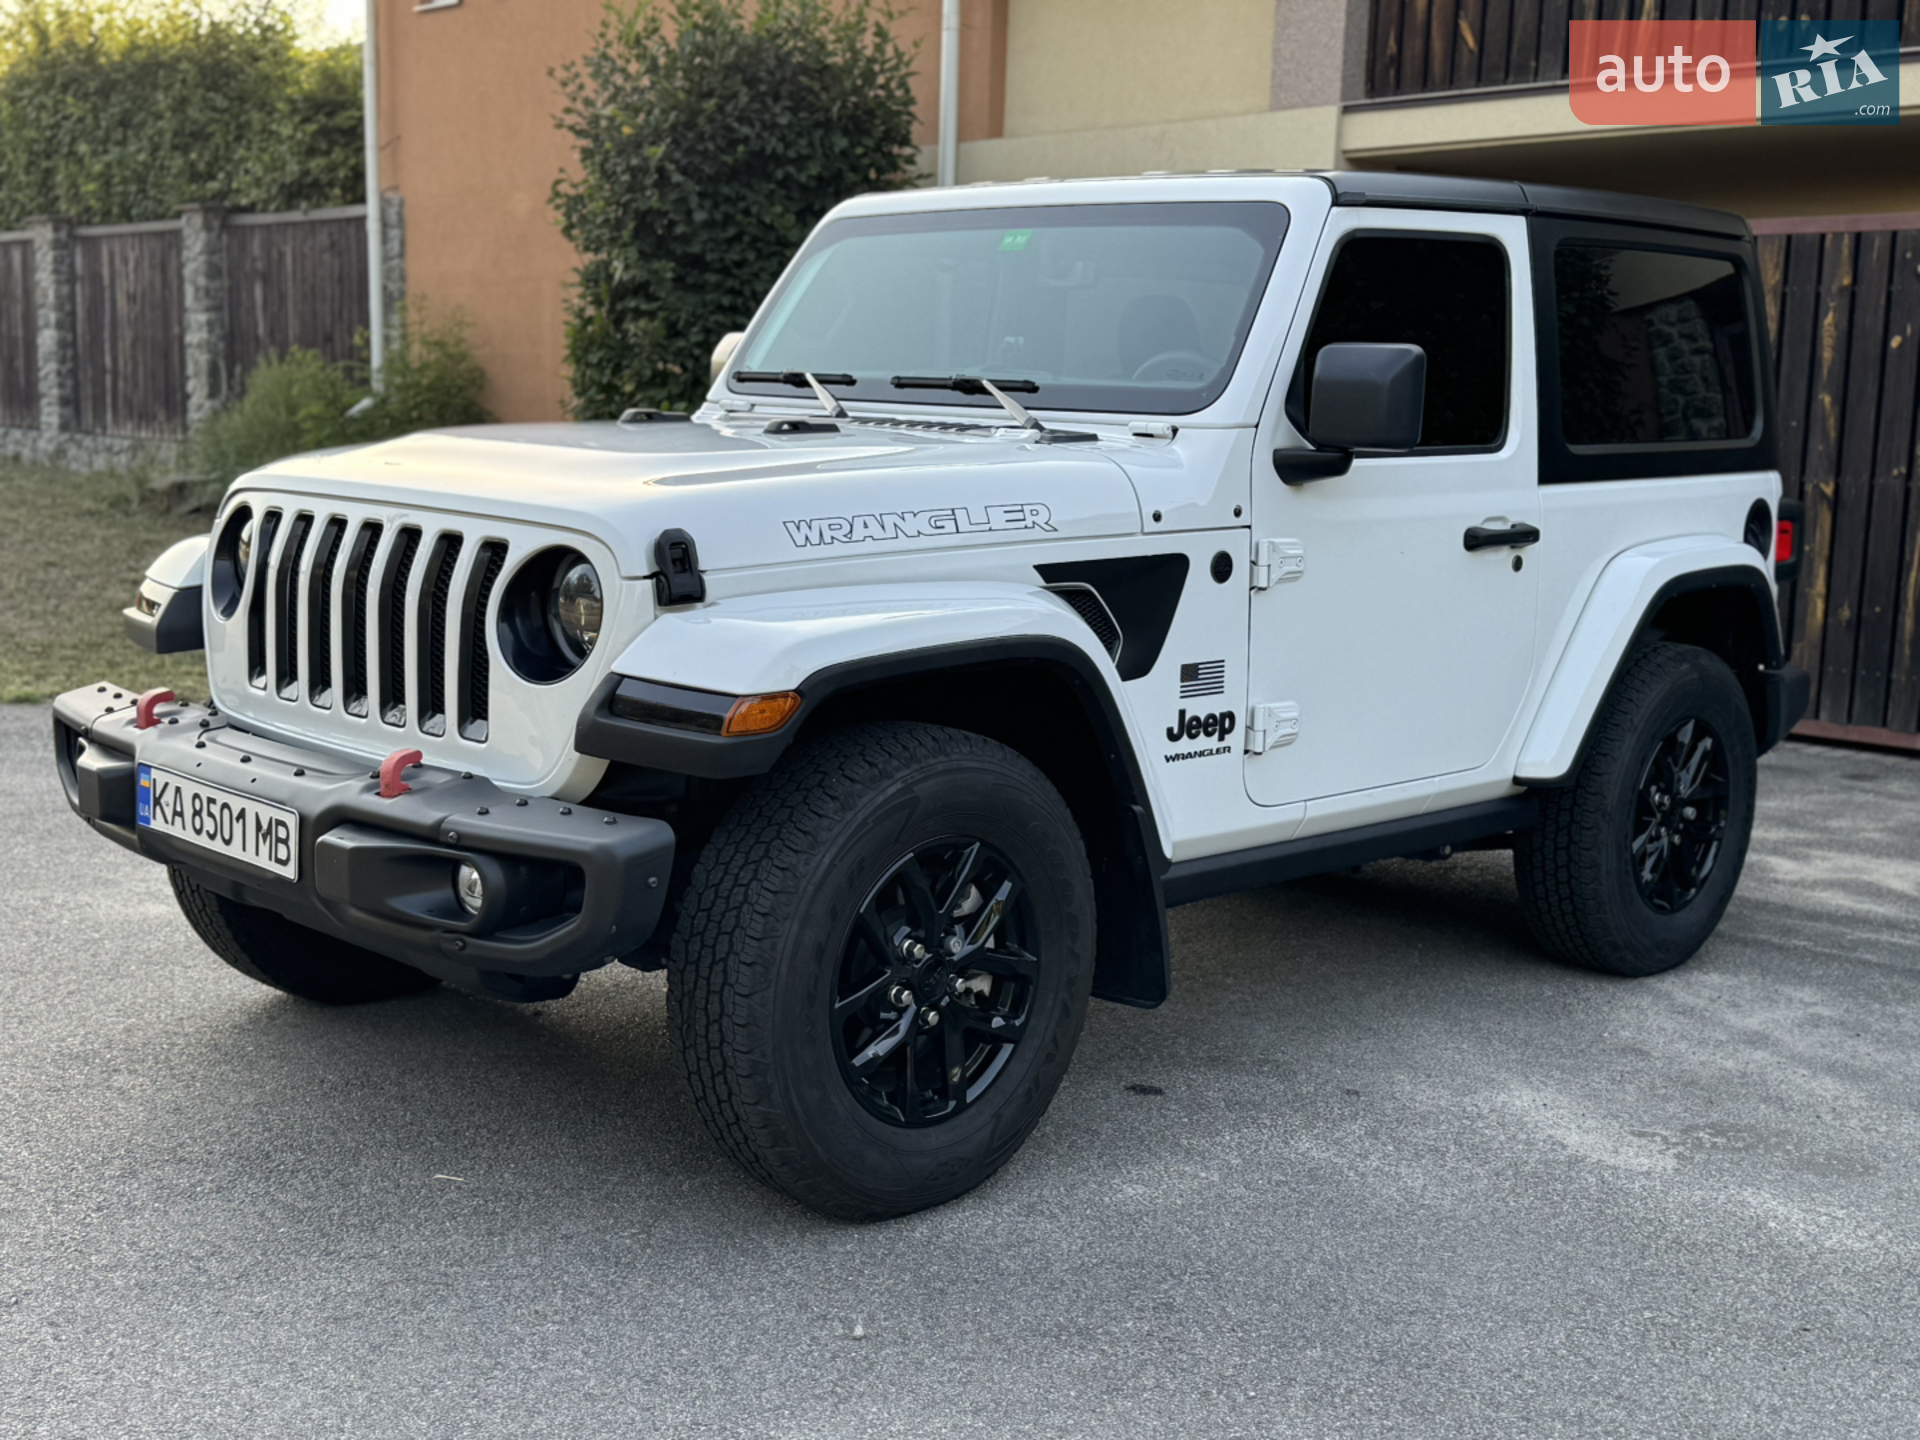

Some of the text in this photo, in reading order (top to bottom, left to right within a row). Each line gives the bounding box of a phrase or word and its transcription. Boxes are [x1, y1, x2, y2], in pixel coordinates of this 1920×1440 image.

[783, 503, 1059, 547] WRANGLER
[1166, 708, 1236, 743] Jeep
[1164, 745, 1232, 763] WRANGLER
[191, 792, 247, 852] 8501
[255, 811, 291, 867] MB
